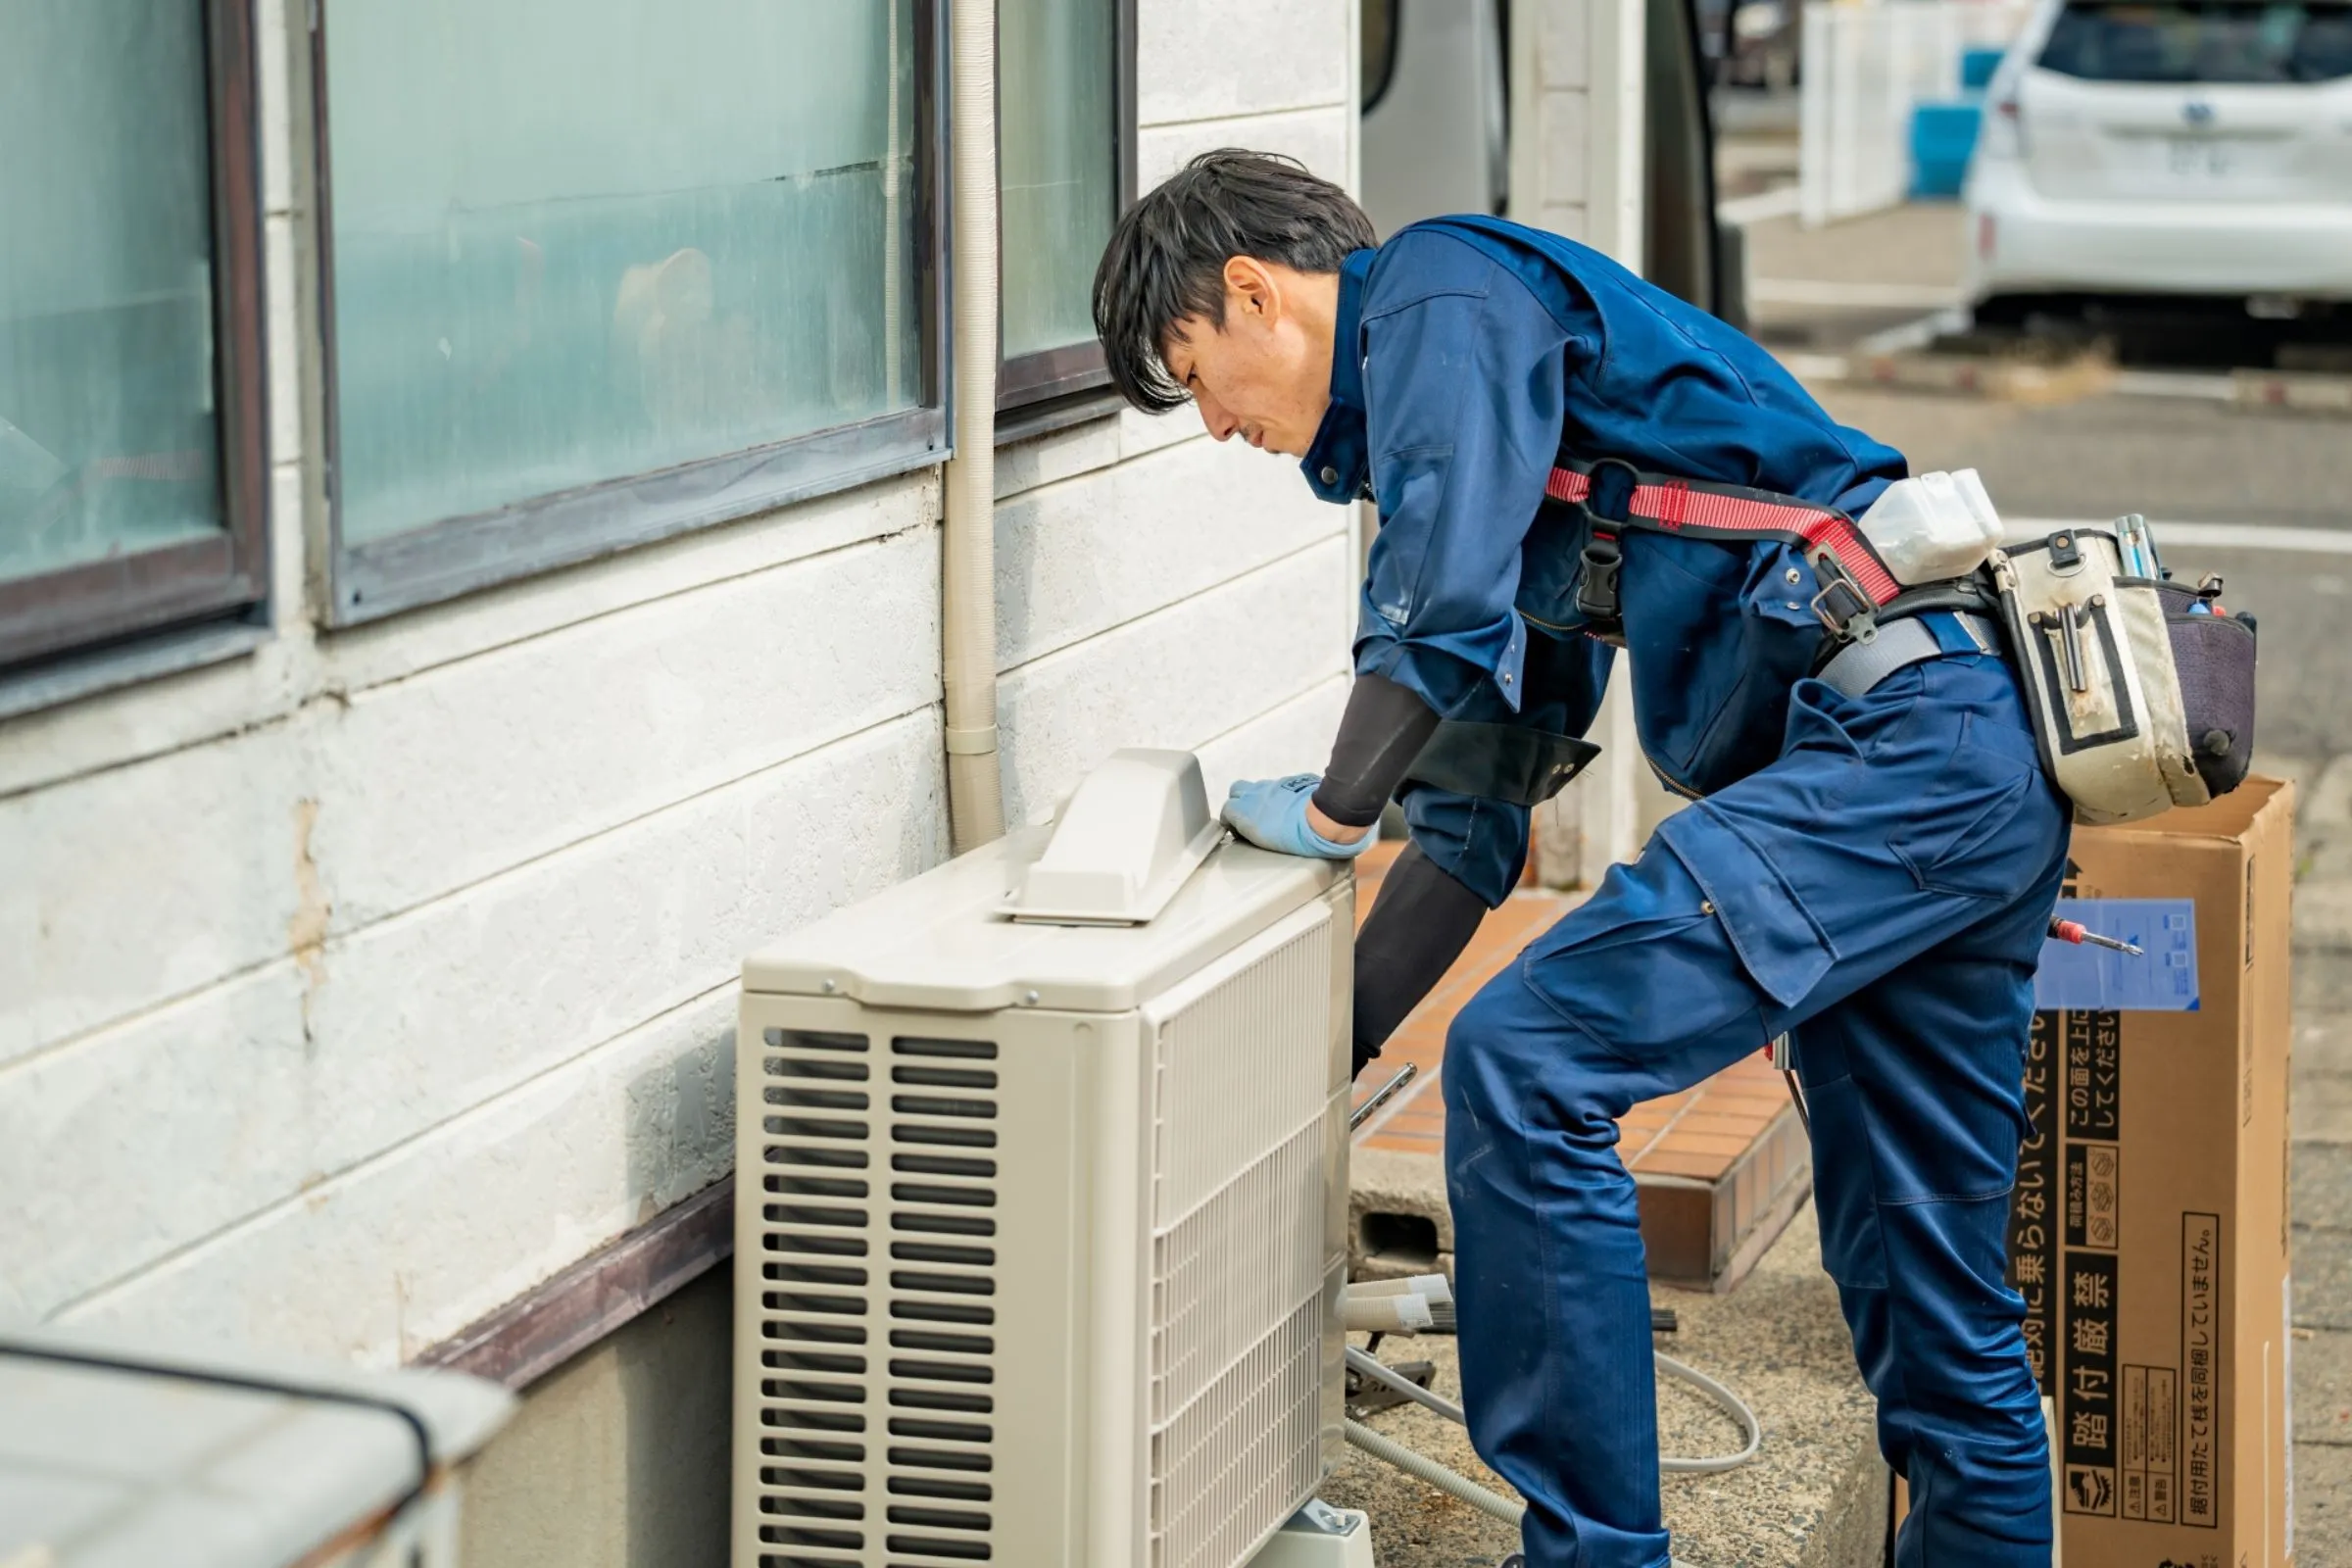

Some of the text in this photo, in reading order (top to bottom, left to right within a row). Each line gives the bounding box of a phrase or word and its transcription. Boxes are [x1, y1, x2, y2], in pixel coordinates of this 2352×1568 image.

[2070, 1009, 2089, 1126] この面を上に
[2095, 1009, 2115, 1128] してください
[2073, 1272, 2108, 1448] 踏付厳禁
[2190, 1229, 2210, 1515] 据付用たて桟を同梱していません。
